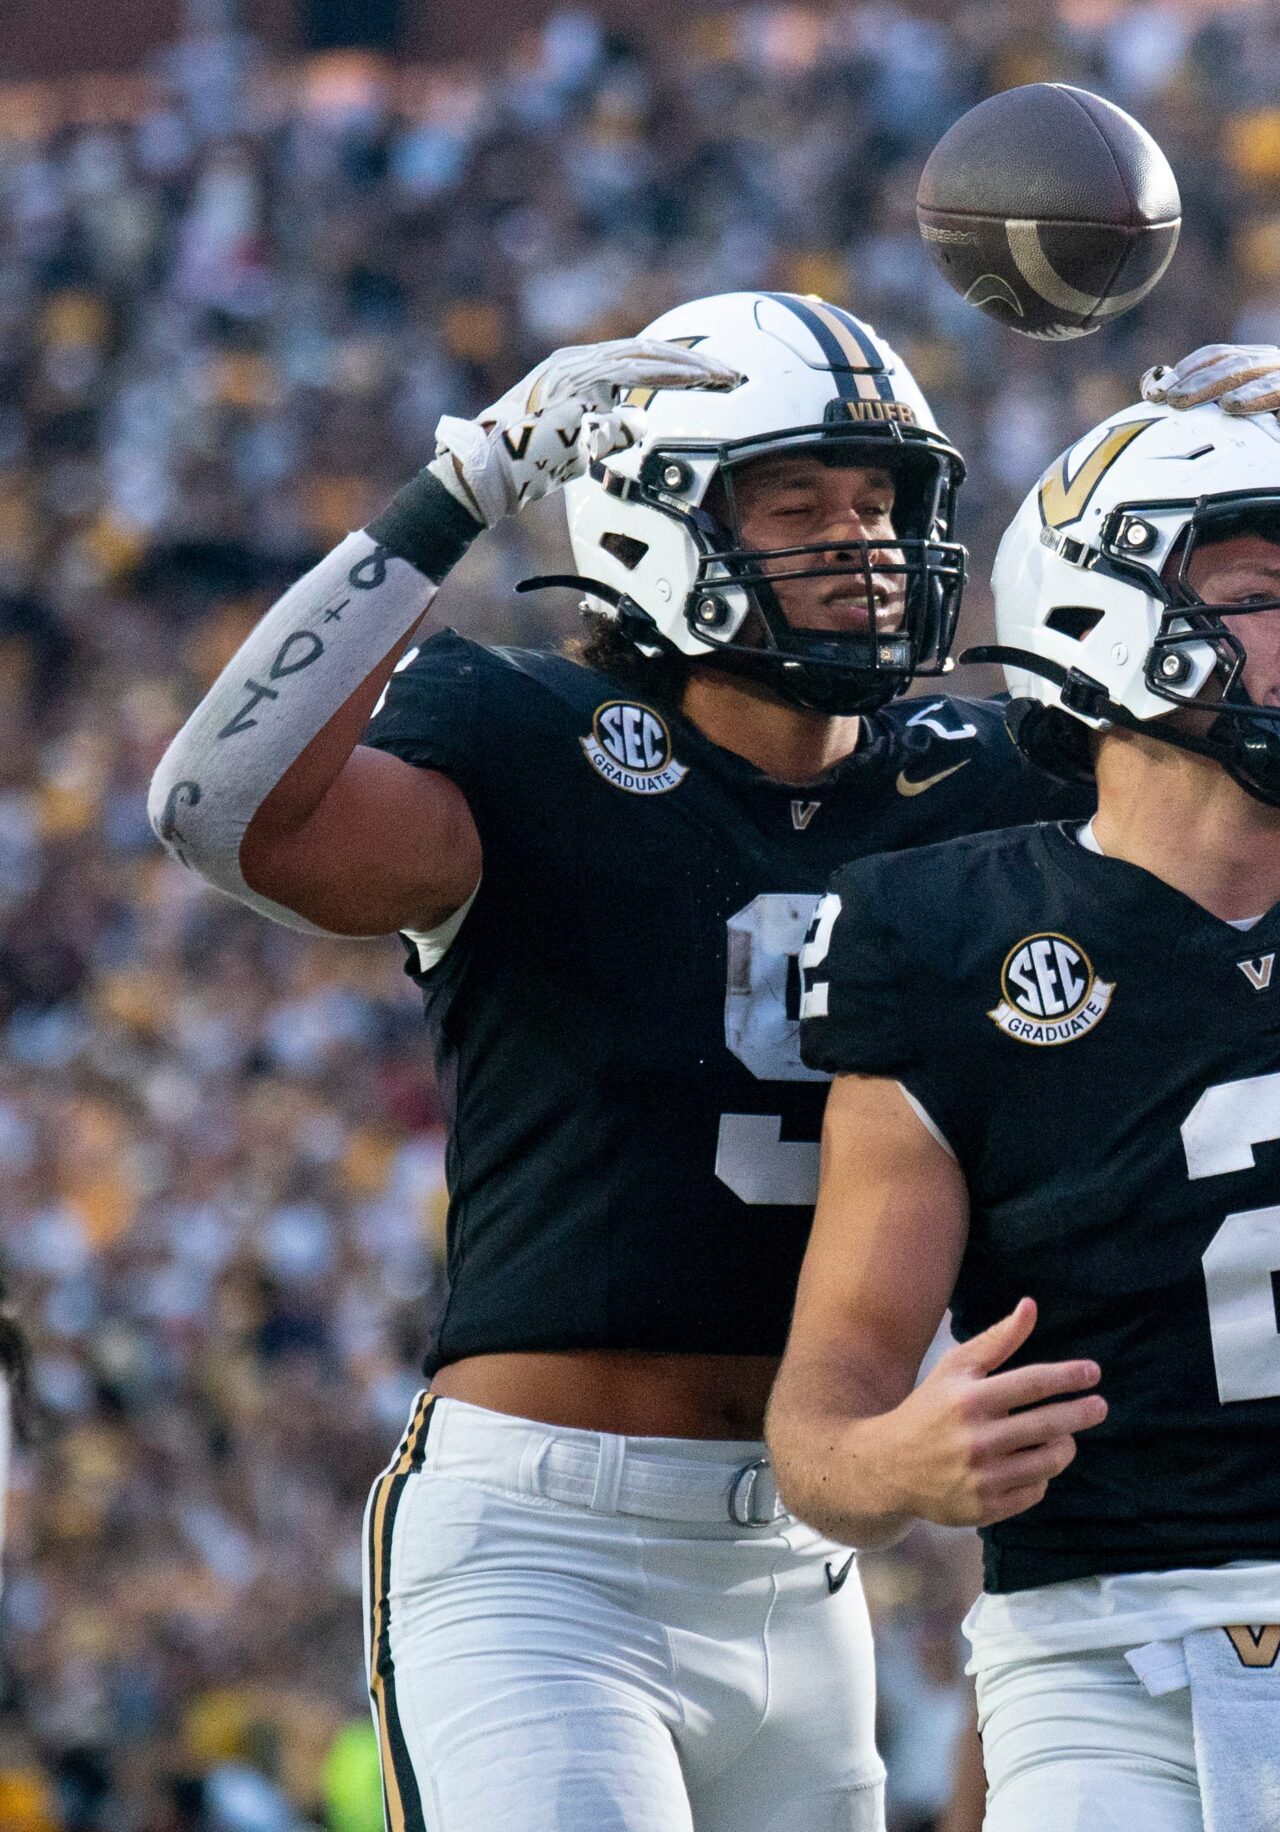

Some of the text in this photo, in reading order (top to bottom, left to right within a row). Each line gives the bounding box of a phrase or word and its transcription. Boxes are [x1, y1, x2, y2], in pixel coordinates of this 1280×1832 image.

[846, 402, 914, 424] VUFB
[501, 423, 535, 461] V
[1038, 416, 1168, 530] V
[600, 706, 665, 768] SEC
[592, 752, 676, 792] GRADUATE
[790, 801, 822, 831] V
[1008, 940, 1086, 1016] SEC
[1237, 953, 1276, 990] V
[1007, 999, 1102, 1042] GRADUATE
